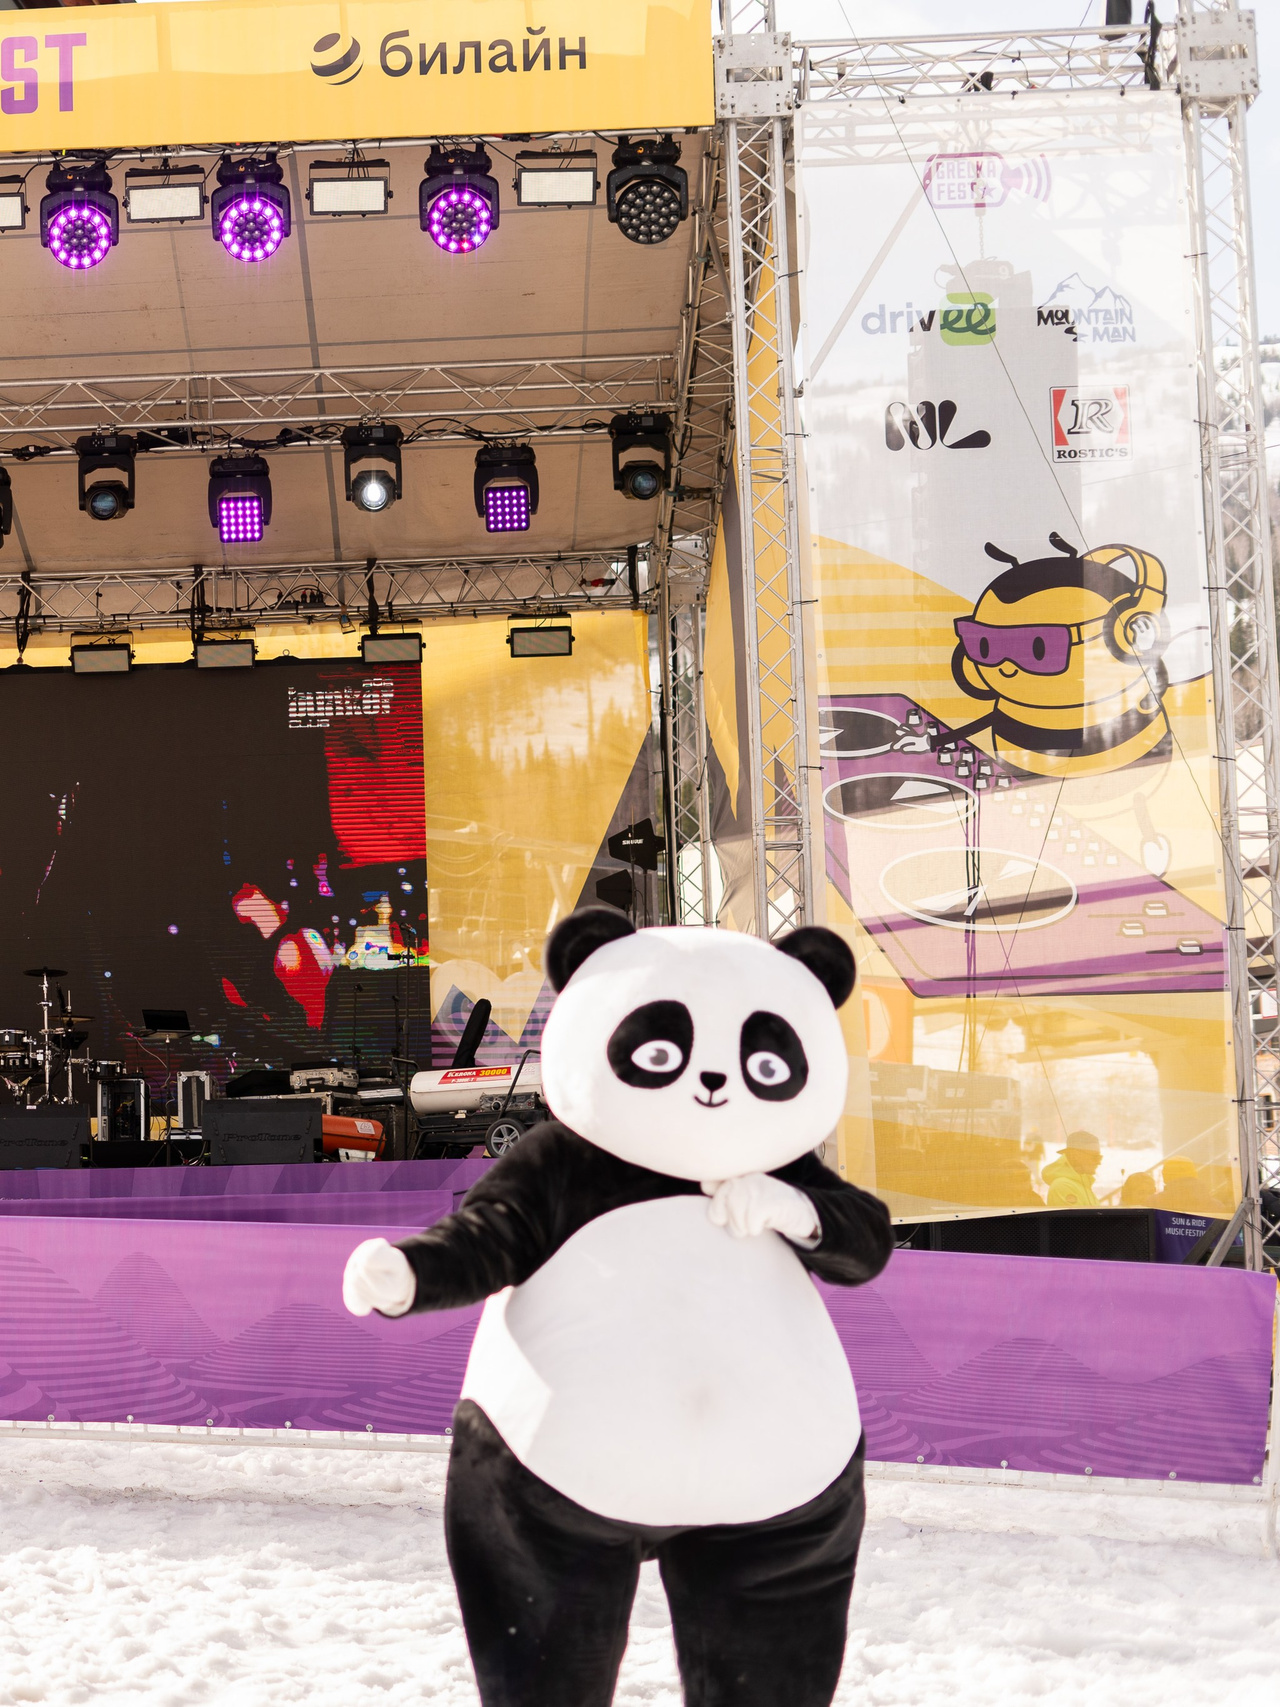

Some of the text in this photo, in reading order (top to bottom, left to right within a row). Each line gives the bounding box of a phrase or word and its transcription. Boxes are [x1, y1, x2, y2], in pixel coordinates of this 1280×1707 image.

[379, 26, 587, 78] билайн
[935, 159, 997, 180] GRELKA
[936, 181, 978, 201] FEST
[861, 301, 996, 335] drivee
[1037, 307, 1134, 327] MOUNTAIN
[1092, 326, 1136, 343] MAN
[1056, 447, 1129, 459] ROSTIC'S
[479, 1068, 508, 1077] 30000
[221, 1132, 303, 1142] ProTone
[1172, 1217, 1206, 1227] SUN & RIDE
[1165, 1228, 1185, 1236] MUSIC
